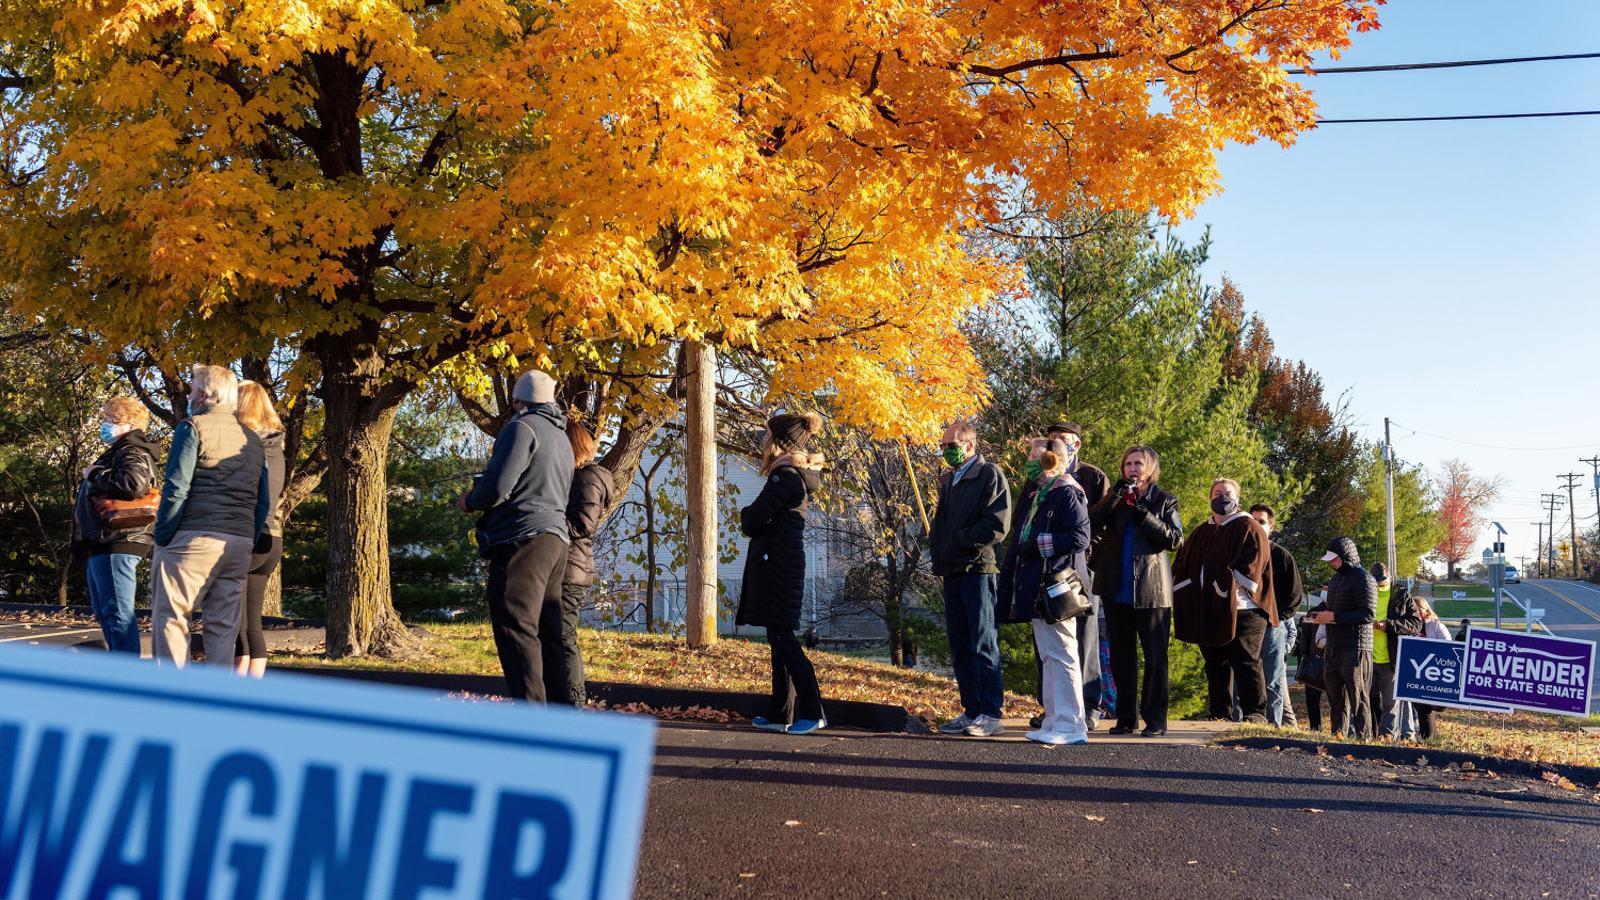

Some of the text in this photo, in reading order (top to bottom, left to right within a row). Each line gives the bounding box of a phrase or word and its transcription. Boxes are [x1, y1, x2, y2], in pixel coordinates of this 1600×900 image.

[1471, 638, 1507, 652] DEB
[1410, 653, 1456, 683] Yes
[1435, 657, 1456, 668] Vote
[1469, 652, 1585, 687] LAVENDER
[1426, 685, 1454, 694] CLEANER
[1467, 675, 1492, 688] FOR
[1495, 678, 1534, 693] STATE
[1536, 684, 1585, 700] SENATE
[0, 723, 574, 900] WAGNER
